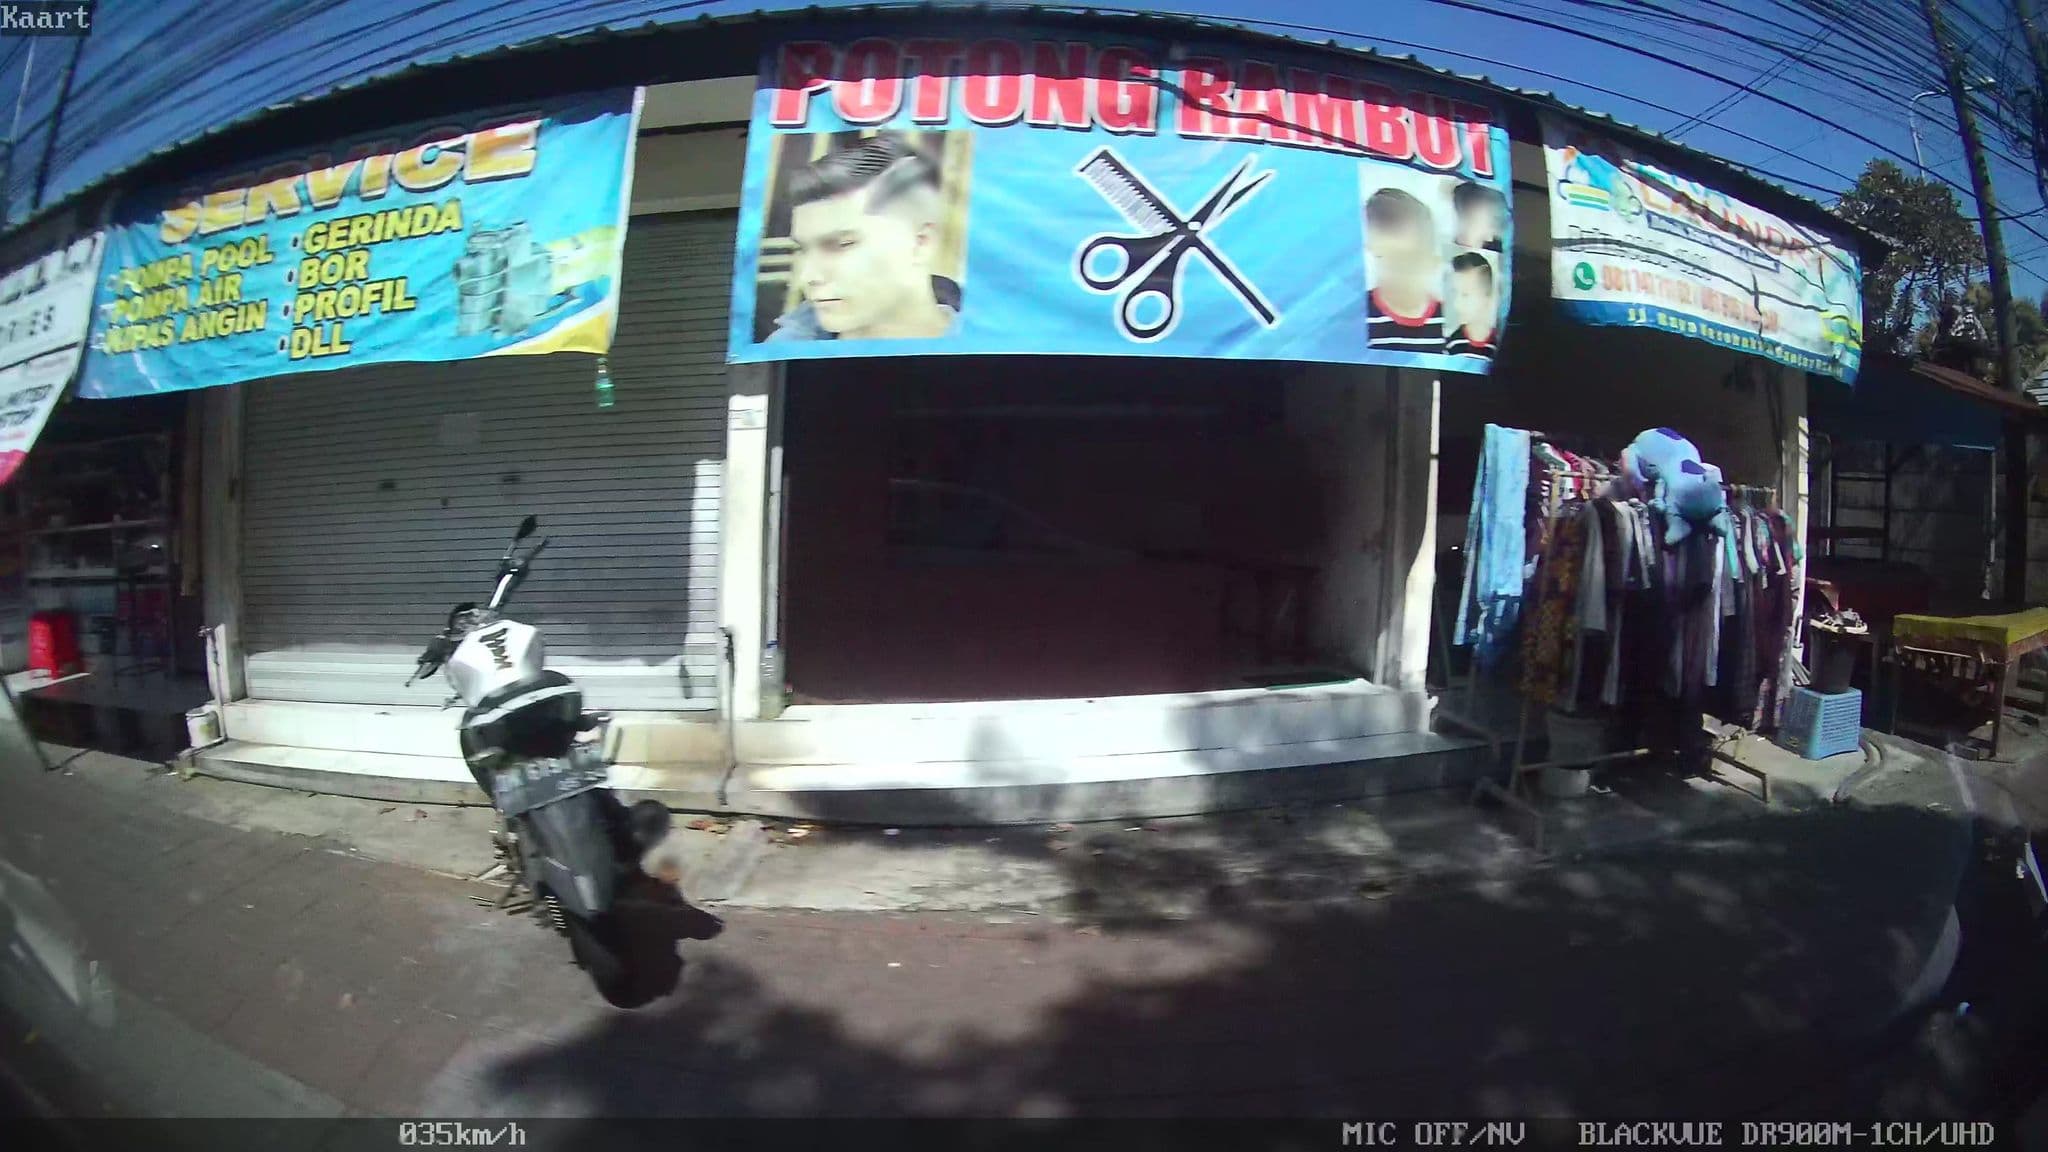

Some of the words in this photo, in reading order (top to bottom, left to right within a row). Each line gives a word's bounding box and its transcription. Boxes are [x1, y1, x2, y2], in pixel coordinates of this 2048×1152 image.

[769, 37, 1160, 136] POTONG
[1176, 56, 1496, 180] RAMBUT
[160, 112, 541, 243] SERVICE
[303, 197, 464, 255] GERINDA
[200, 234, 275, 277] POOL
[297, 248, 370, 290] BOR
[197, 272, 243, 308] AIR
[293, 276, 419, 325] PROFIL
[179, 298, 269, 344] ANGIN
[289, 321, 353, 361] DLL
